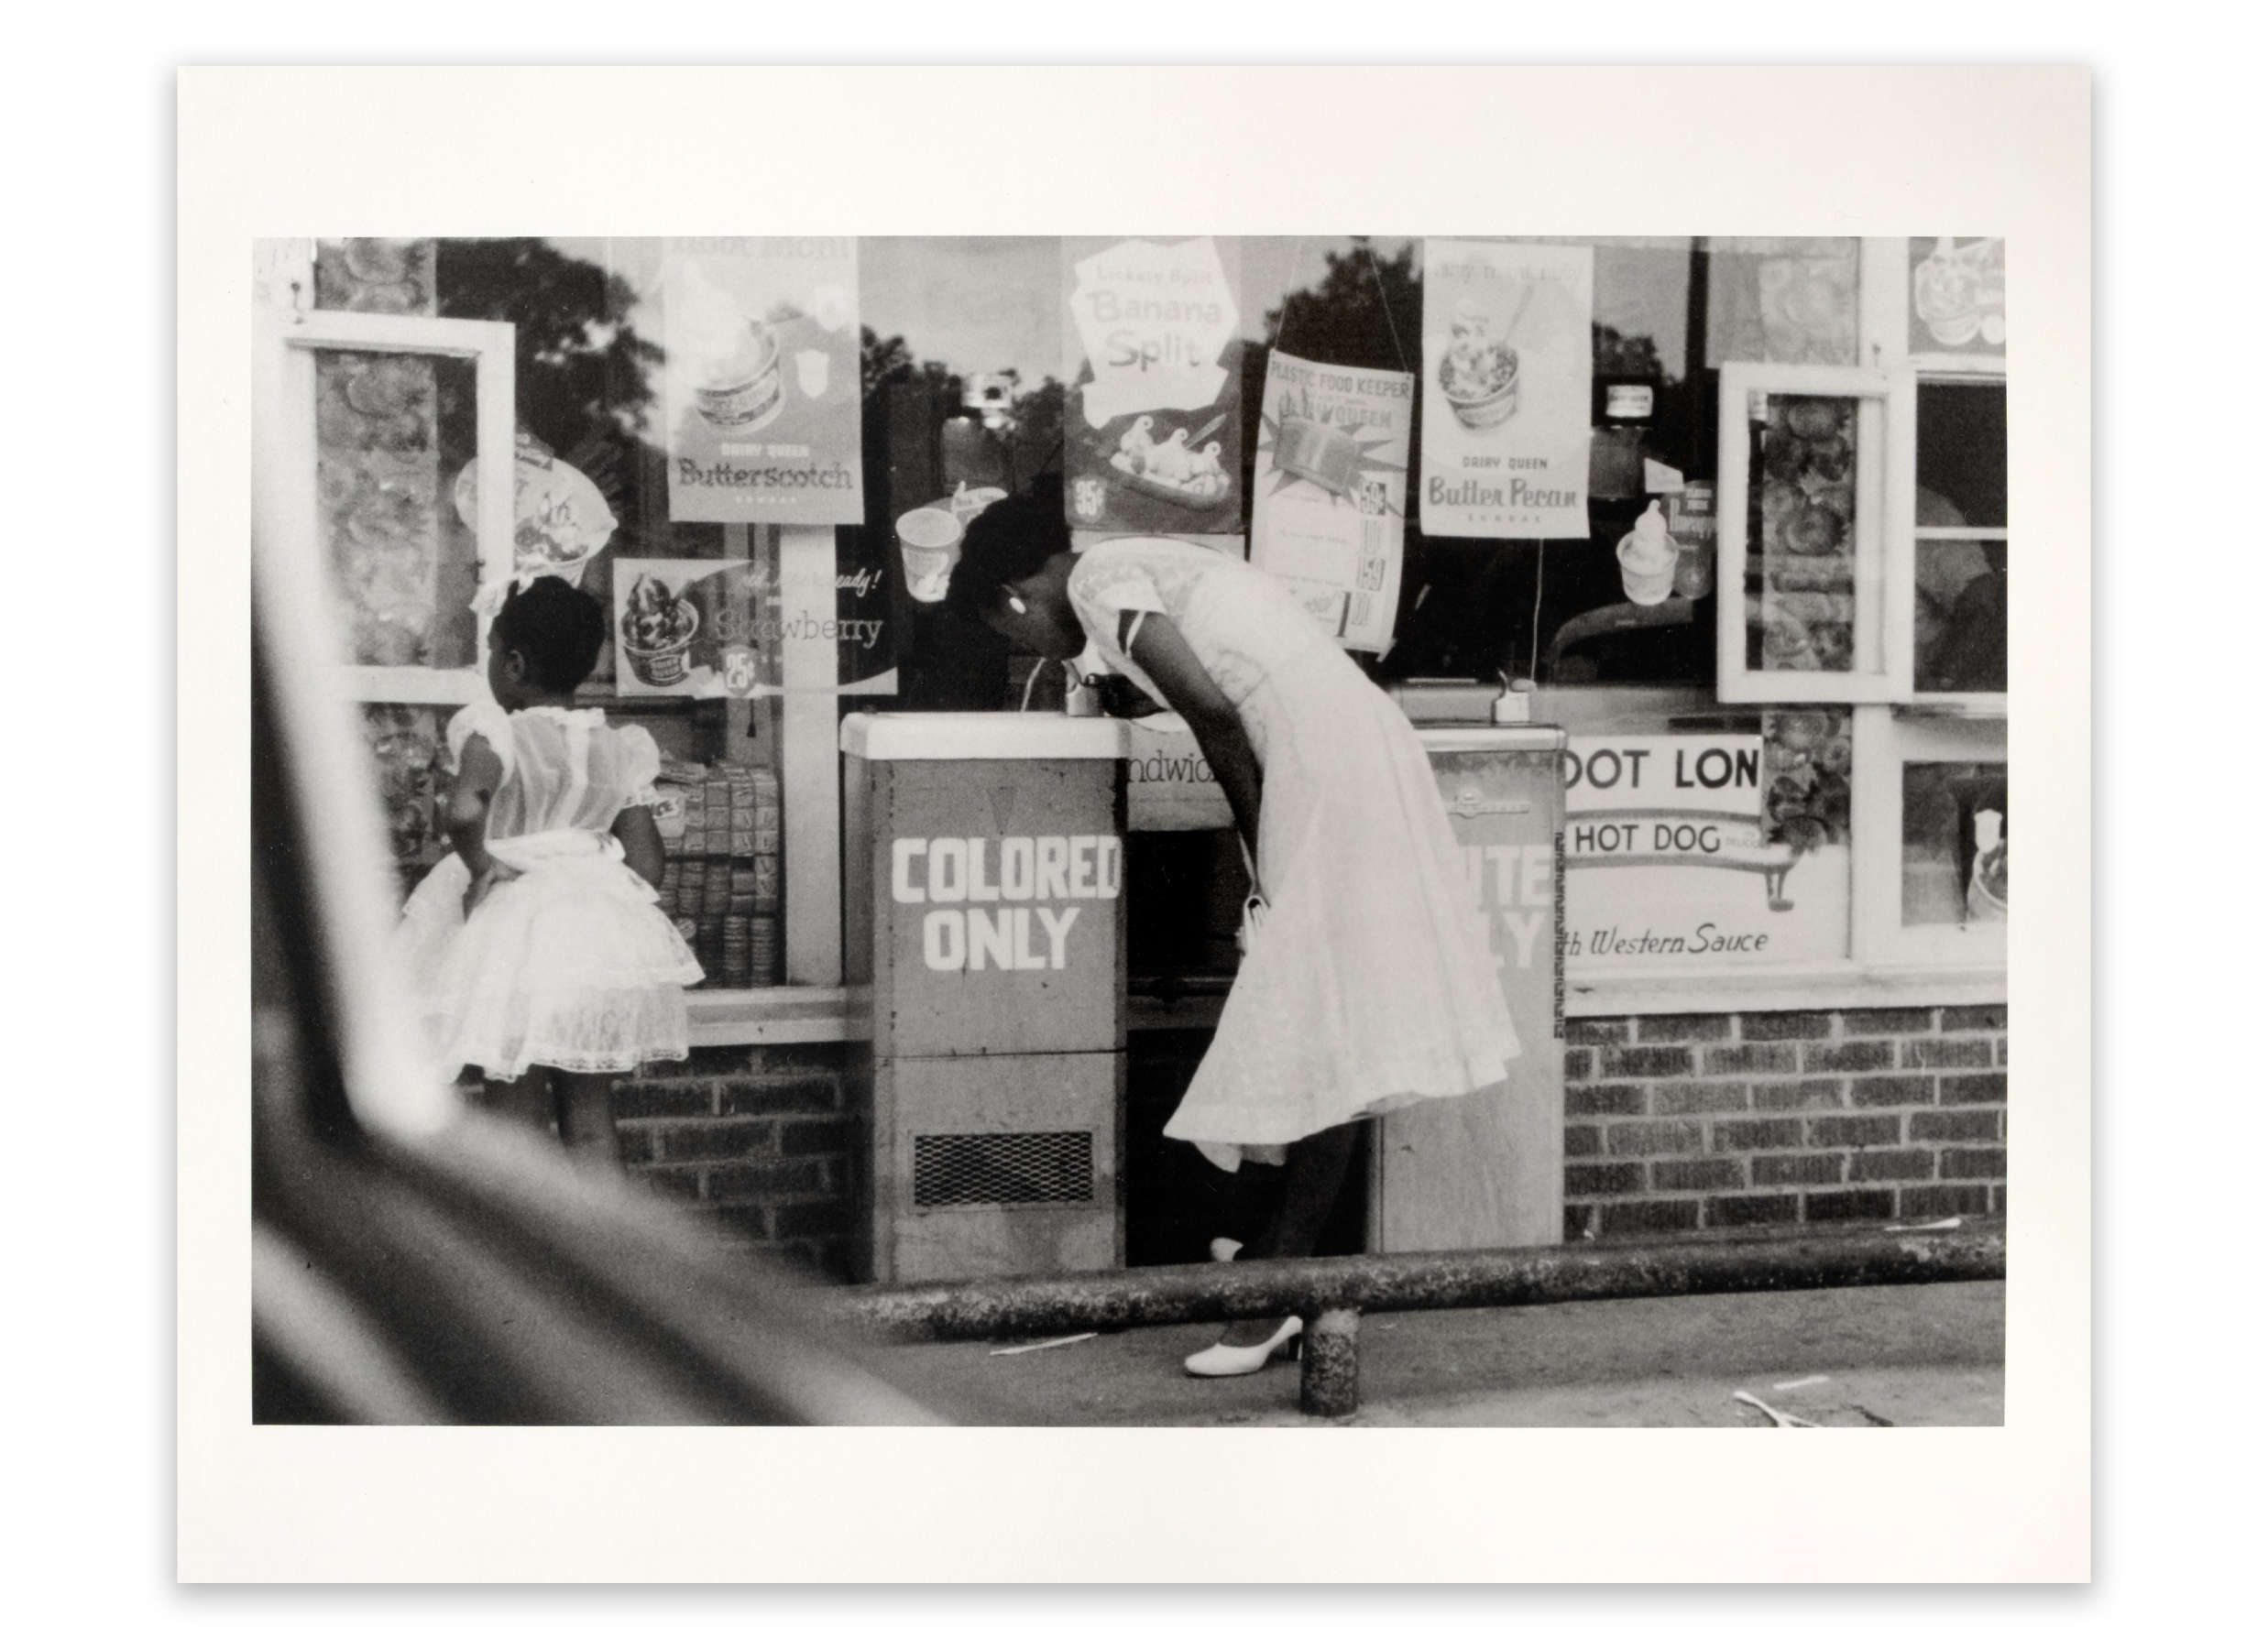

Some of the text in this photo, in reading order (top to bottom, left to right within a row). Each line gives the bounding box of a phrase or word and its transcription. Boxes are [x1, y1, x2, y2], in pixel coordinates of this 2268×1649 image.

[1085, 289, 1222, 325] Banana
[1105, 328, 1201, 372] Split
[1270, 360, 1317, 388] PLASTIC
[1319, 373, 1353, 394] FOOD
[1356, 377, 1411, 400] KEEPER
[678, 457, 854, 490] Butterscotch
[1463, 456, 1550, 471] DAIRY QUEEN
[1429, 475, 1579, 508] Butter Pecan
[716, 609, 883, 650] Strawberry
[1128, 748, 1217, 784] ndwic
[1675, 748, 1759, 790] LON
[1575, 824, 1639, 852] HOT
[1654, 824, 1721, 853] DOG
[893, 835, 1123, 903] COLORED
[1461, 845, 1551, 905] ITE
[923, 907, 1080, 970] ONLY
[1590, 925, 1684, 955] Western
[1687, 923, 1769, 954] Sauce
